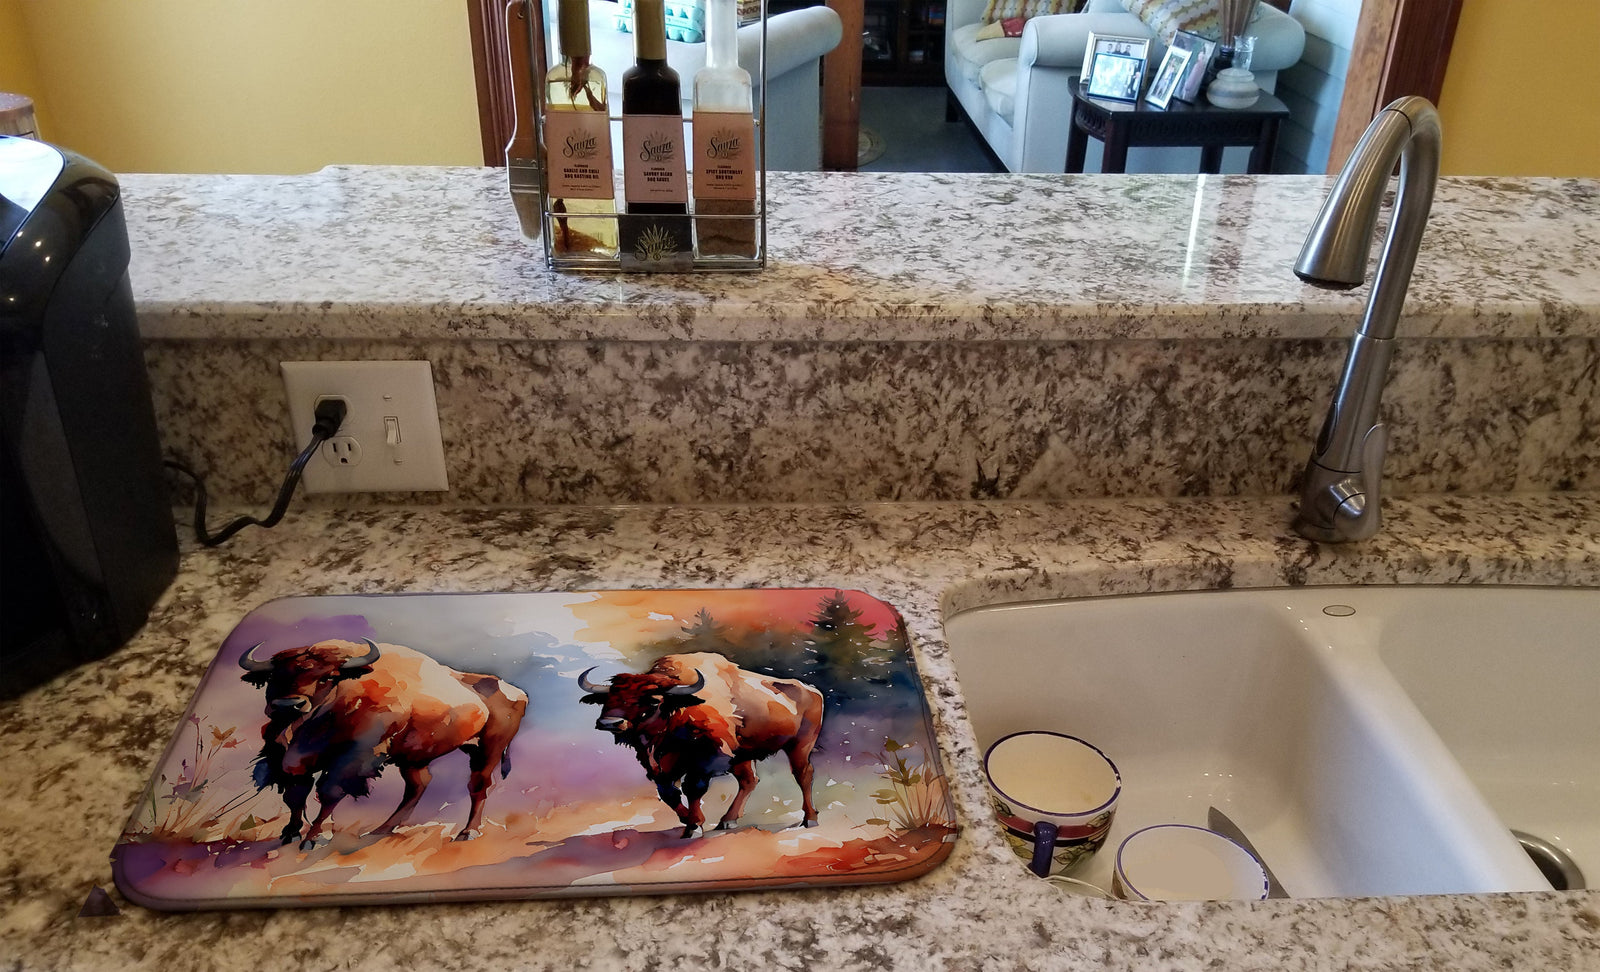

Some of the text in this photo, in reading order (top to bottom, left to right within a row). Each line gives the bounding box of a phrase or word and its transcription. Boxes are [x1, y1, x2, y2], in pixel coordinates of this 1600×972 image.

[563, 136, 598, 158] Sauza
[640, 140, 674, 162] Sauza
[707, 136, 740, 159] Sauza
